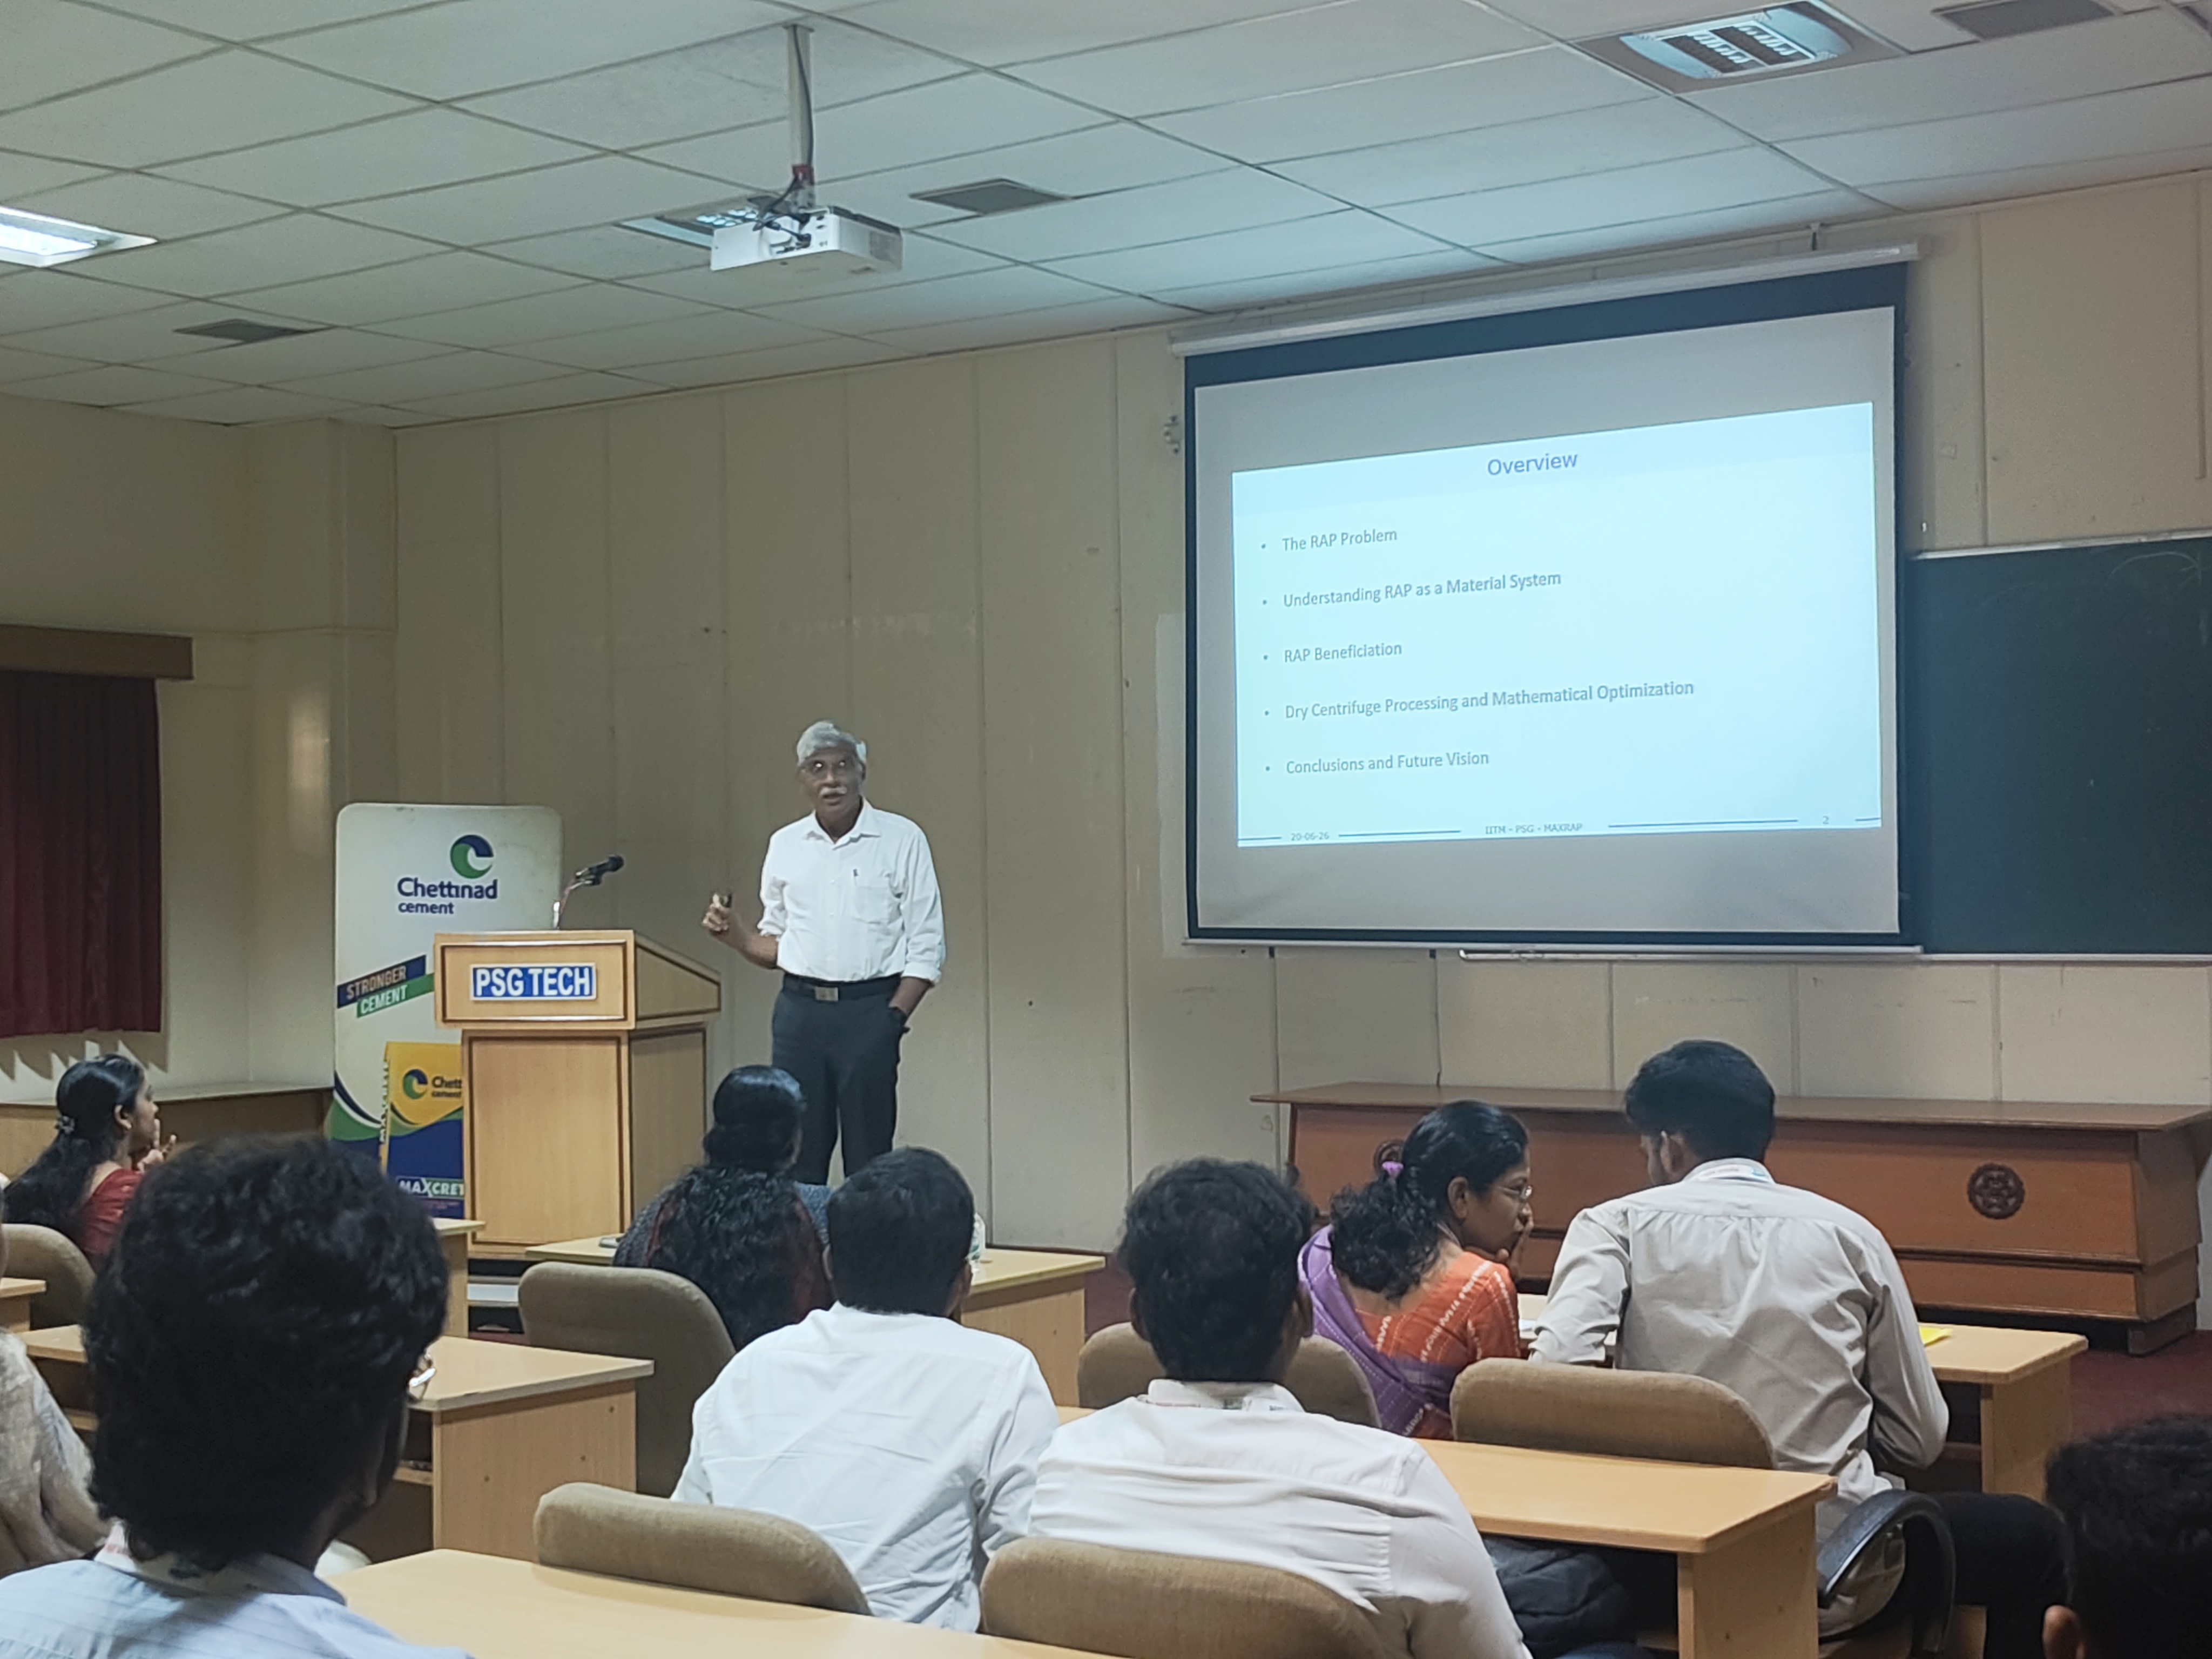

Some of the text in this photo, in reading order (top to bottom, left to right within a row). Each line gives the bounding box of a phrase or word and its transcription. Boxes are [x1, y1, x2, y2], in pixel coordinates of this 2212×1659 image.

[1487, 453, 1578, 475] Overview
[1282, 529, 1398, 551] The RAP Problem
[1284, 573, 1562, 608] Understanding RAP as a Material System
[1285, 643, 1402, 663] RAP Beneficiation
[1285, 680, 1695, 721] Dry Centrifuge Processing and Mathematical Optimization
[1286, 751, 1489, 774] Conclusions and Future Vision
[1485, 826, 1506, 834] IITM
[1515, 825, 1534, 833] PSG
[1544, 823, 1583, 832] MAXRAP
[1822, 815, 1830, 825] 2
[1291, 832, 1330, 841] 20-06-26
[398, 902, 455, 914] cement
[347, 966, 407, 999] STRONGER
[476, 967, 590, 996] PSG TECH
[361, 984, 408, 1014] CEMENT
